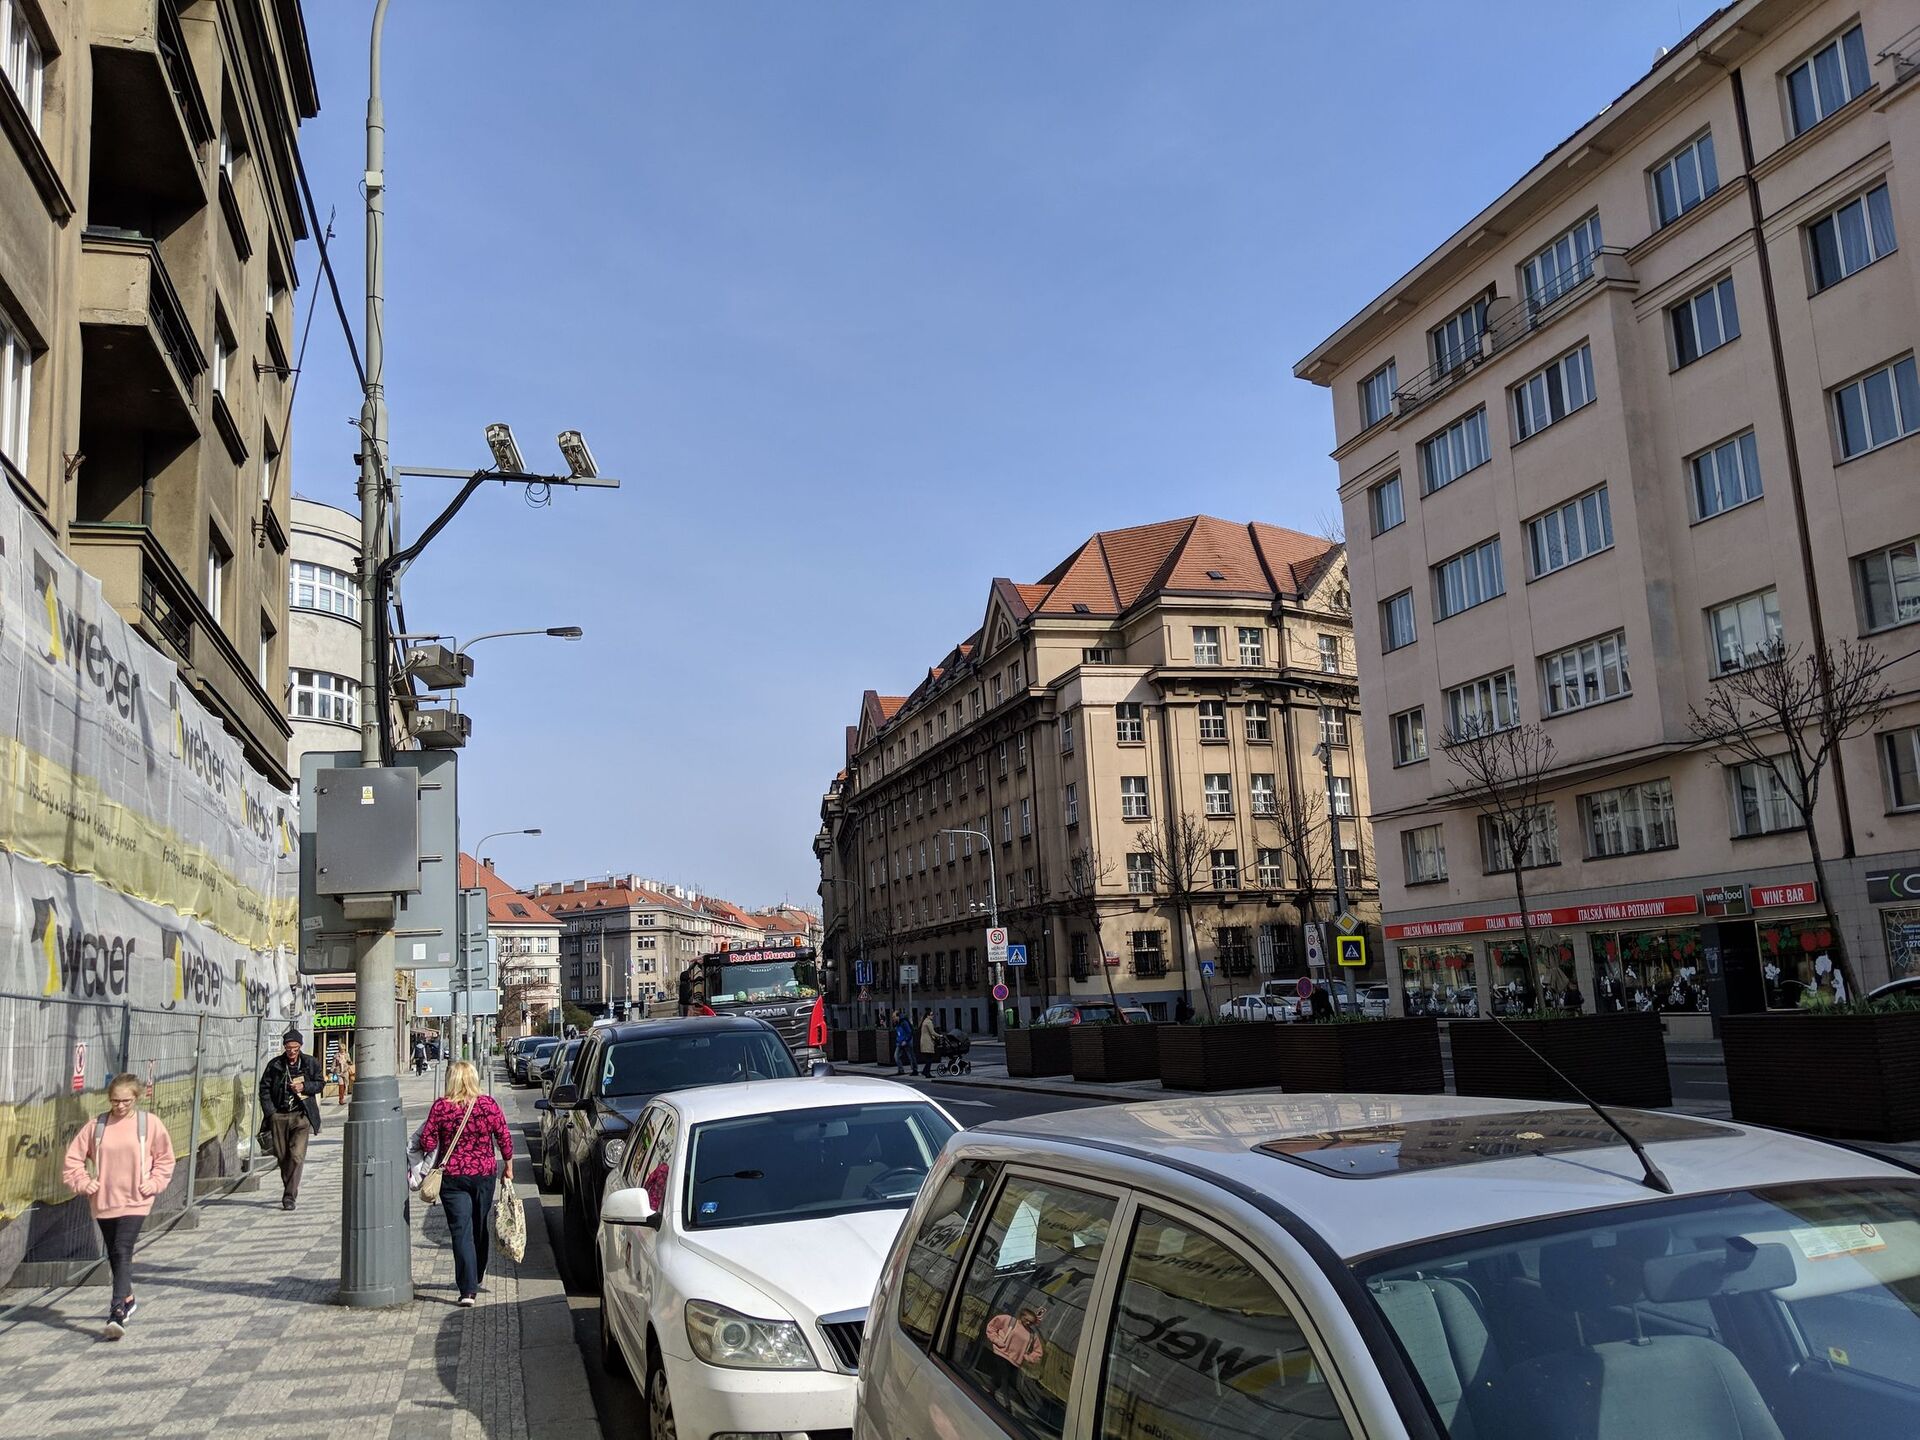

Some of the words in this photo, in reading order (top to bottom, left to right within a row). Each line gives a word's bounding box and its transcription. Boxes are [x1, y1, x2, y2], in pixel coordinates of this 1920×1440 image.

[56, 597, 140, 724] weber
[180, 712, 227, 798] weber
[1705, 893, 1724, 902] wine
[1724, 889, 1743, 900] food
[1761, 890, 1784, 905] WINE
[1786, 887, 1805, 902] BAR
[1578, 905, 1604, 921] ITALSKÁ
[1604, 905, 1622, 919] VÍNA
[1622, 906, 1627, 917] A
[1628, 902, 1665, 917] POTRAVINY
[1403, 924, 1422, 936] ITALSKÁ
[1421, 923, 1434, 935] VÍNA
[1438, 921, 1465, 933] POTRAVINY
[1485, 917, 1507, 929] ITALIAN
[1536, 913, 1553, 924] FOOD
[993, 933, 1002, 941] 50
[57, 920, 136, 997] weber
[730, 953, 762, 963] Radek
[763, 951, 796, 961] Muran
[182, 941, 223, 1008] weber
[313, 1013, 356, 1027] Country
[744, 1007, 788, 1017] SCANIA
